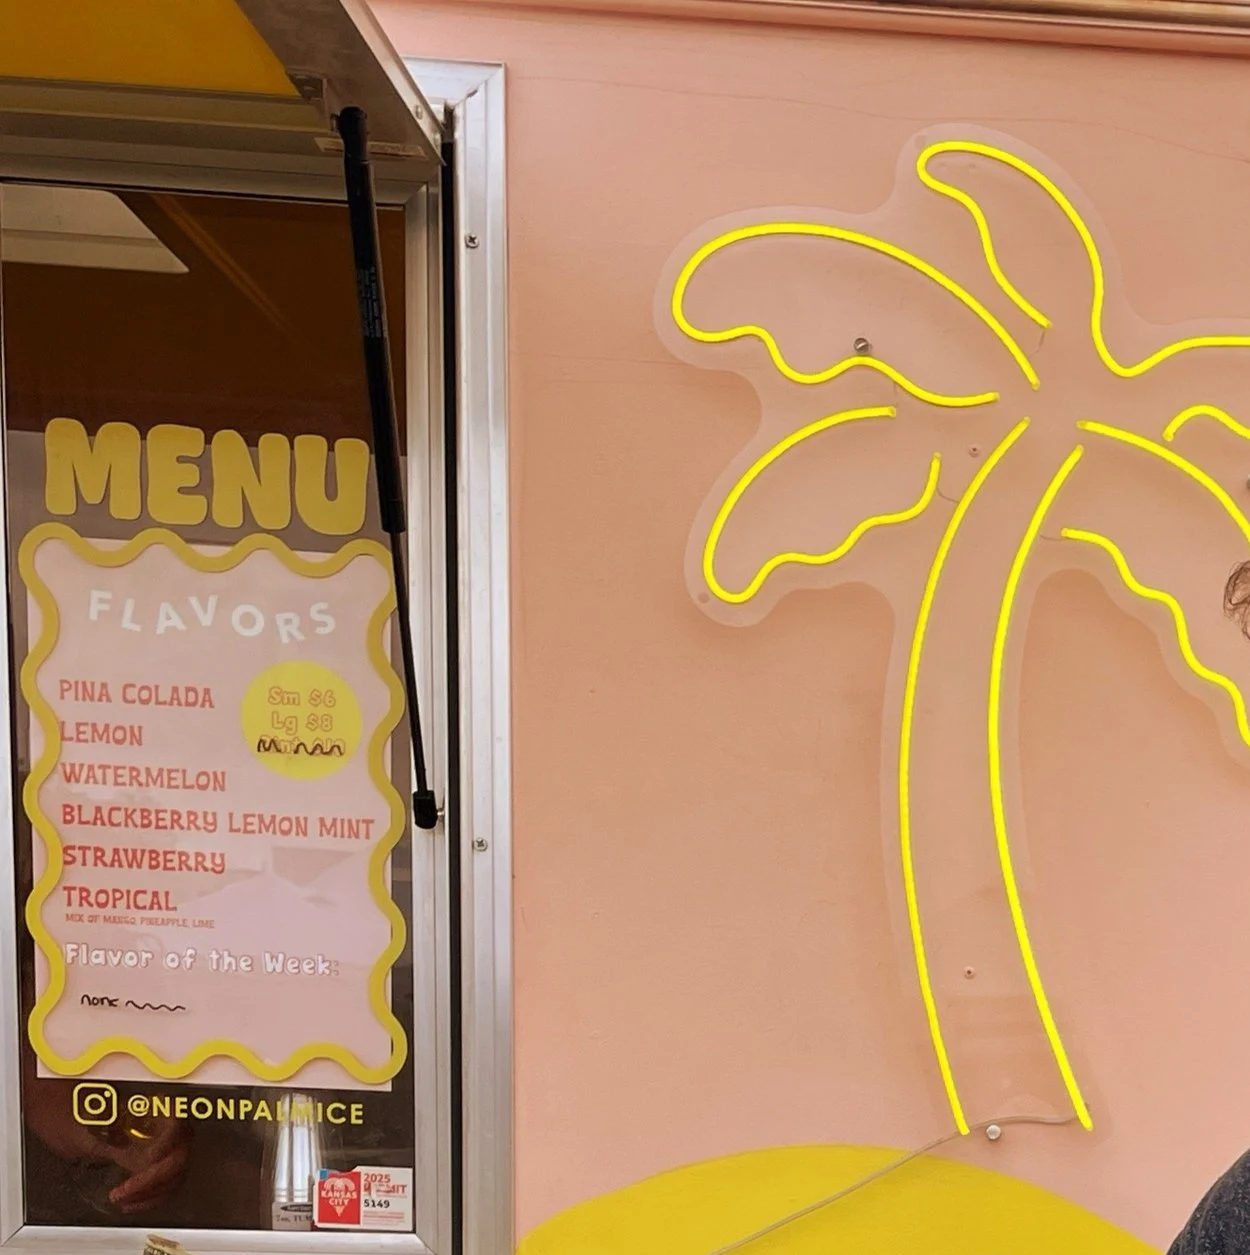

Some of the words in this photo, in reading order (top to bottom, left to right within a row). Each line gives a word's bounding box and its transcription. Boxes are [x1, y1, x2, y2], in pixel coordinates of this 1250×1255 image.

[44, 417, 370, 536] MENU
[87, 589, 337, 644] FLAVORS
[59, 679, 112, 703] PINA
[122, 683, 215, 709] COLADA
[268, 686, 300, 706] Sm
[308, 688, 337, 708] $6
[60, 720, 143, 746] LEMON
[271, 711, 298, 736] Lg
[306, 713, 333, 732] $8
[61, 762, 226, 792] WATERMELON
[62, 803, 218, 833] BLACKBERRY
[228, 812, 308, 837] LEMON
[318, 816, 375, 840] MINT
[62, 845, 225, 875] STRAWBERRY
[63, 886, 177, 912] TROPICAL
[64, 943, 154, 968] Flavor
[163, 947, 197, 970] of
[208, 950, 253, 973] the
[263, 951, 339, 976] Week:
[128, 1094, 363, 1125] @NEONPALMICE
[363, 1173, 391, 1184] 2025
[321, 1189, 357, 1200] KANSAS
[363, 1199, 390, 1208] 5149
